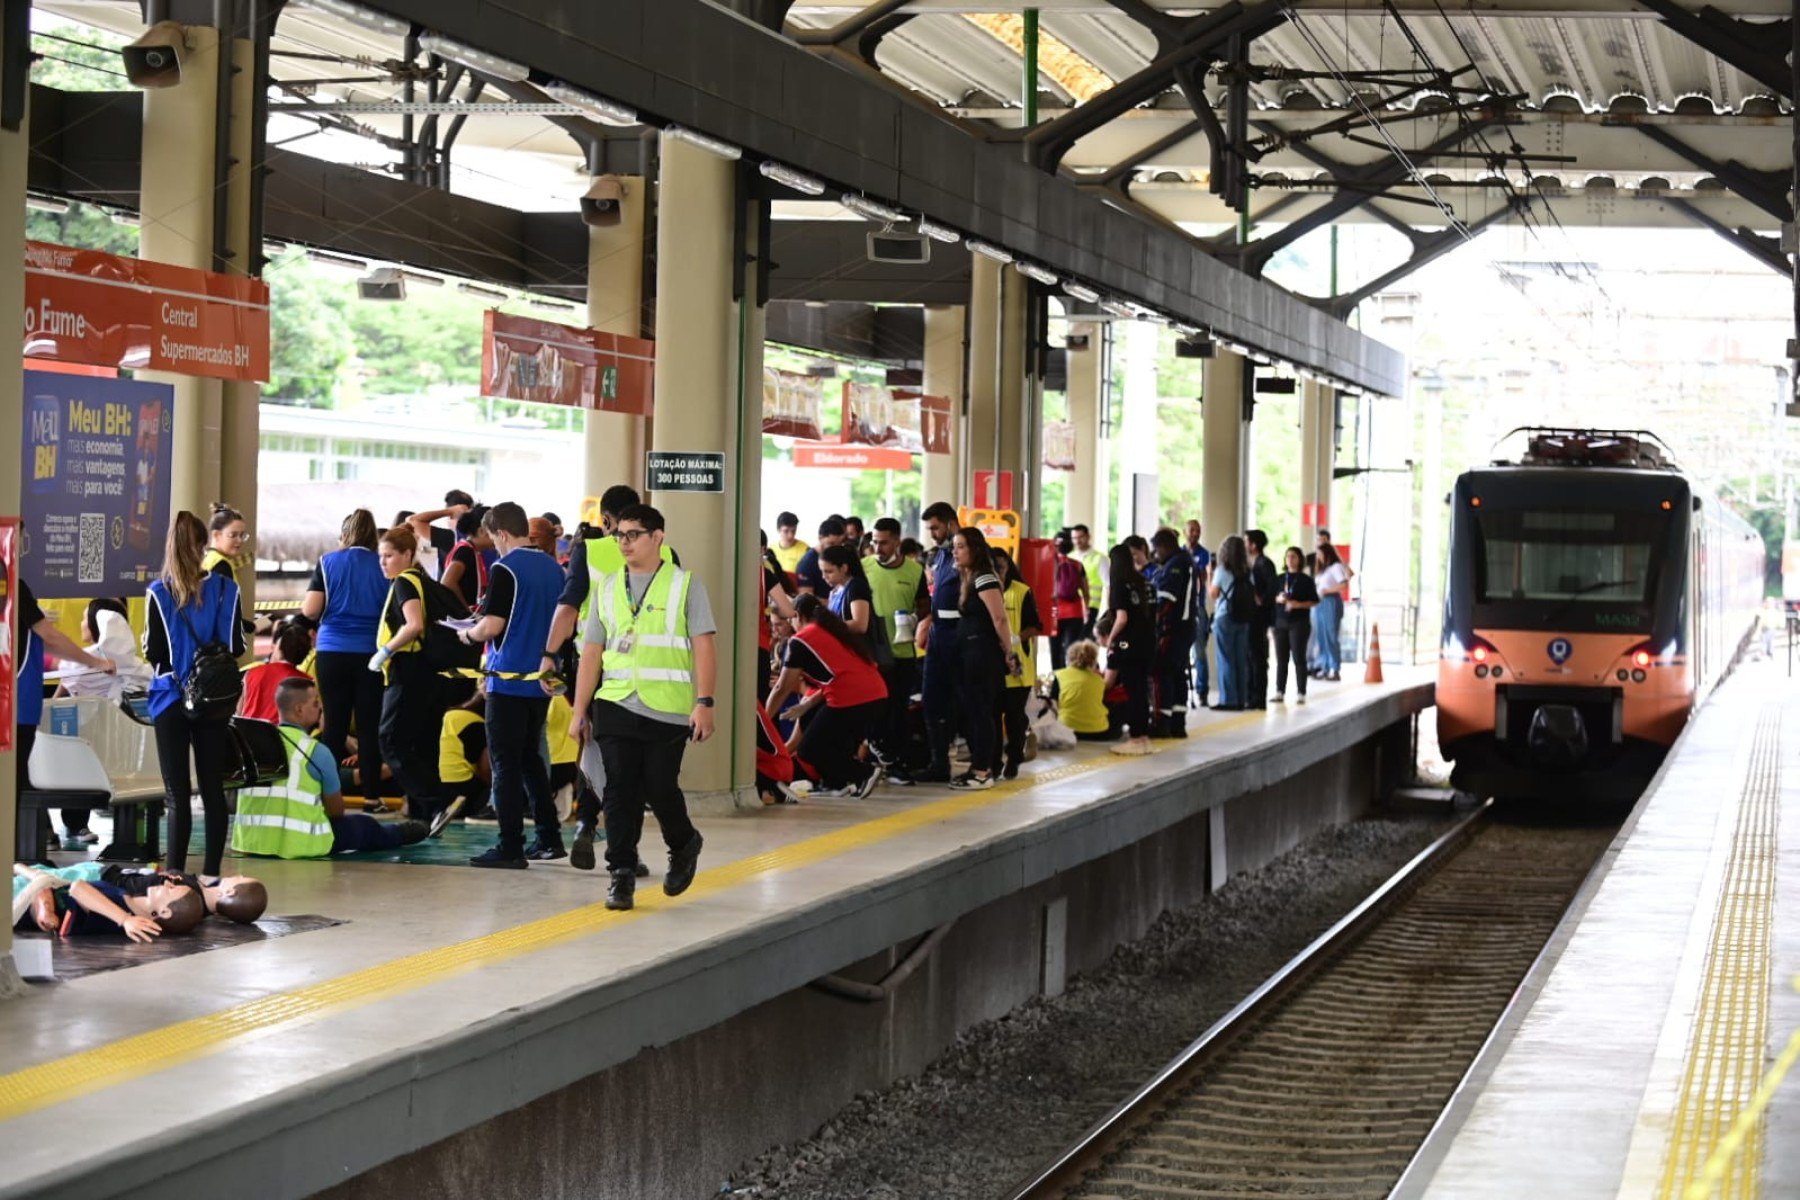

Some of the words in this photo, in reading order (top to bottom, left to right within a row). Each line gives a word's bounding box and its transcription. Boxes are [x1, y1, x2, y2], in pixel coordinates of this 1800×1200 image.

[40, 298, 86, 339] Fume
[161, 301, 198, 329] Central
[160, 334, 233, 366] Supermercados
[234, 343, 249, 367] BH
[68, 399, 101, 434] Meu
[105, 402, 133, 437] BH:
[33, 445, 57, 480] BH
[649, 458, 686, 471] LOTAÇÃO
[84, 480, 103, 498] para
[657, 473, 673, 484] 300
[674, 473, 714, 485] PESSOAS
